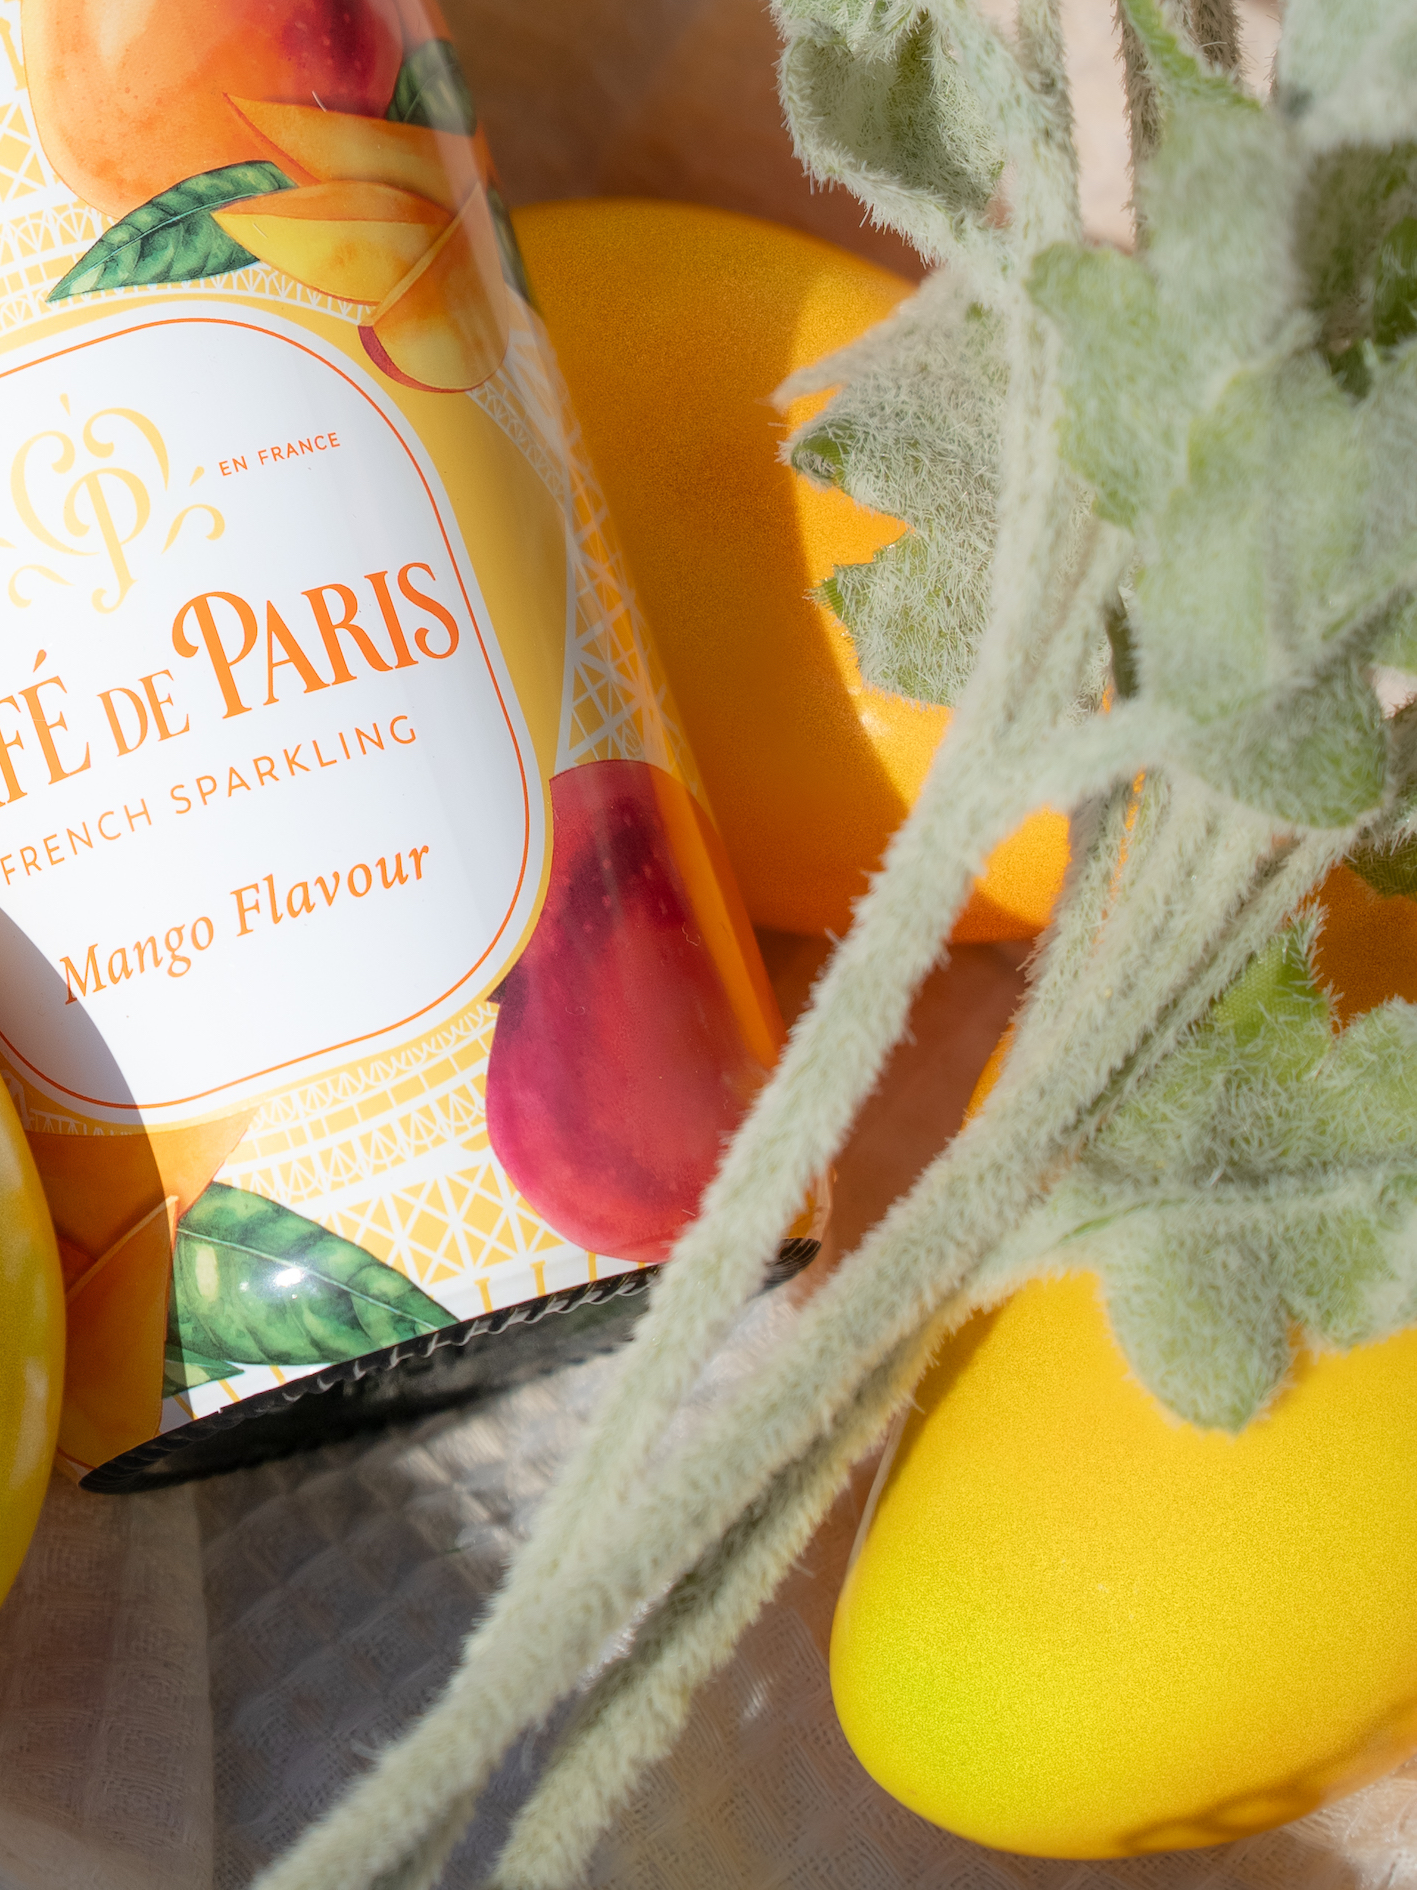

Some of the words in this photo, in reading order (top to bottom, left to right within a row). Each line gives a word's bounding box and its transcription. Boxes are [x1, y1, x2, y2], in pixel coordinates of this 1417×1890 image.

[218, 458, 248, 476] EN
[257, 431, 341, 465] FRANCE
[97, 669, 190, 756] DE
[171, 562, 460, 720] PARIS
[171, 716, 417, 814] SPARKLING
[59, 915, 214, 1005] Mango
[230, 843, 431, 937] Flavour
